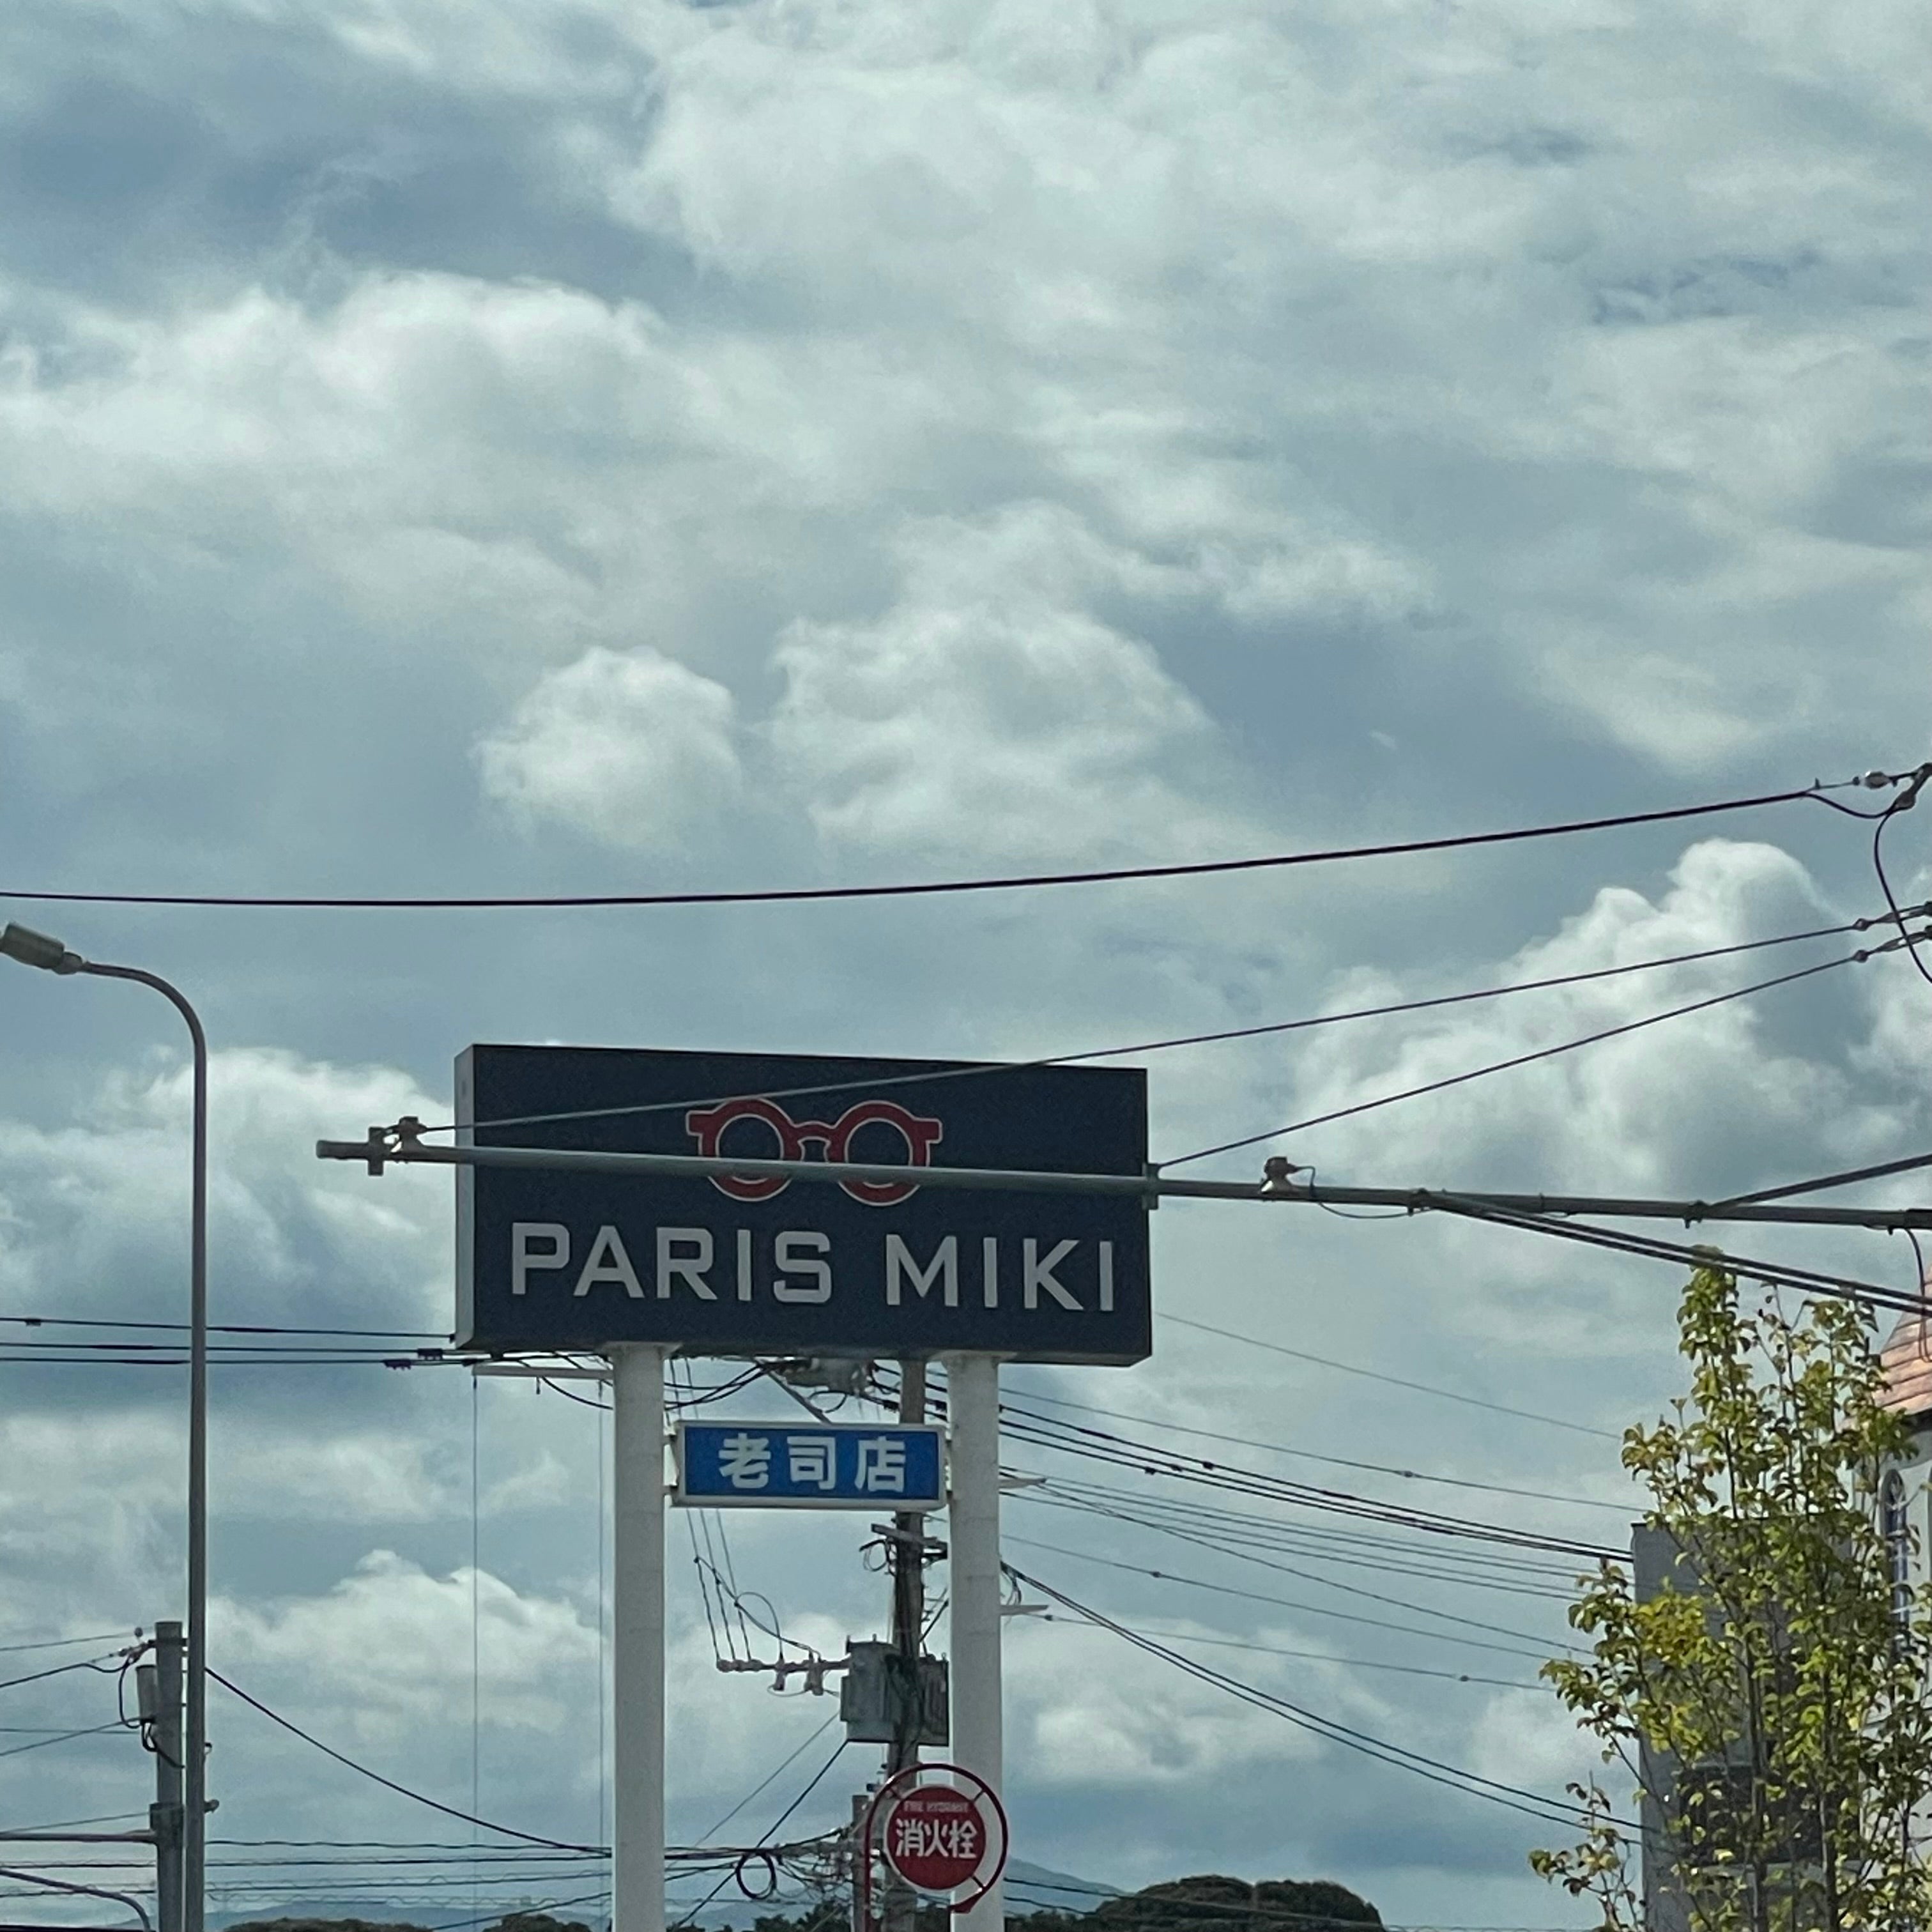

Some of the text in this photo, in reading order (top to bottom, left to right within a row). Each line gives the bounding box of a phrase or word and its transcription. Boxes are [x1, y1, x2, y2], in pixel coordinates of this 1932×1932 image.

[511, 1222, 1114, 1312] PARIS MIKI
[718, 1433, 907, 1493] 老司店
[896, 1818, 977, 1859] 消火栓
